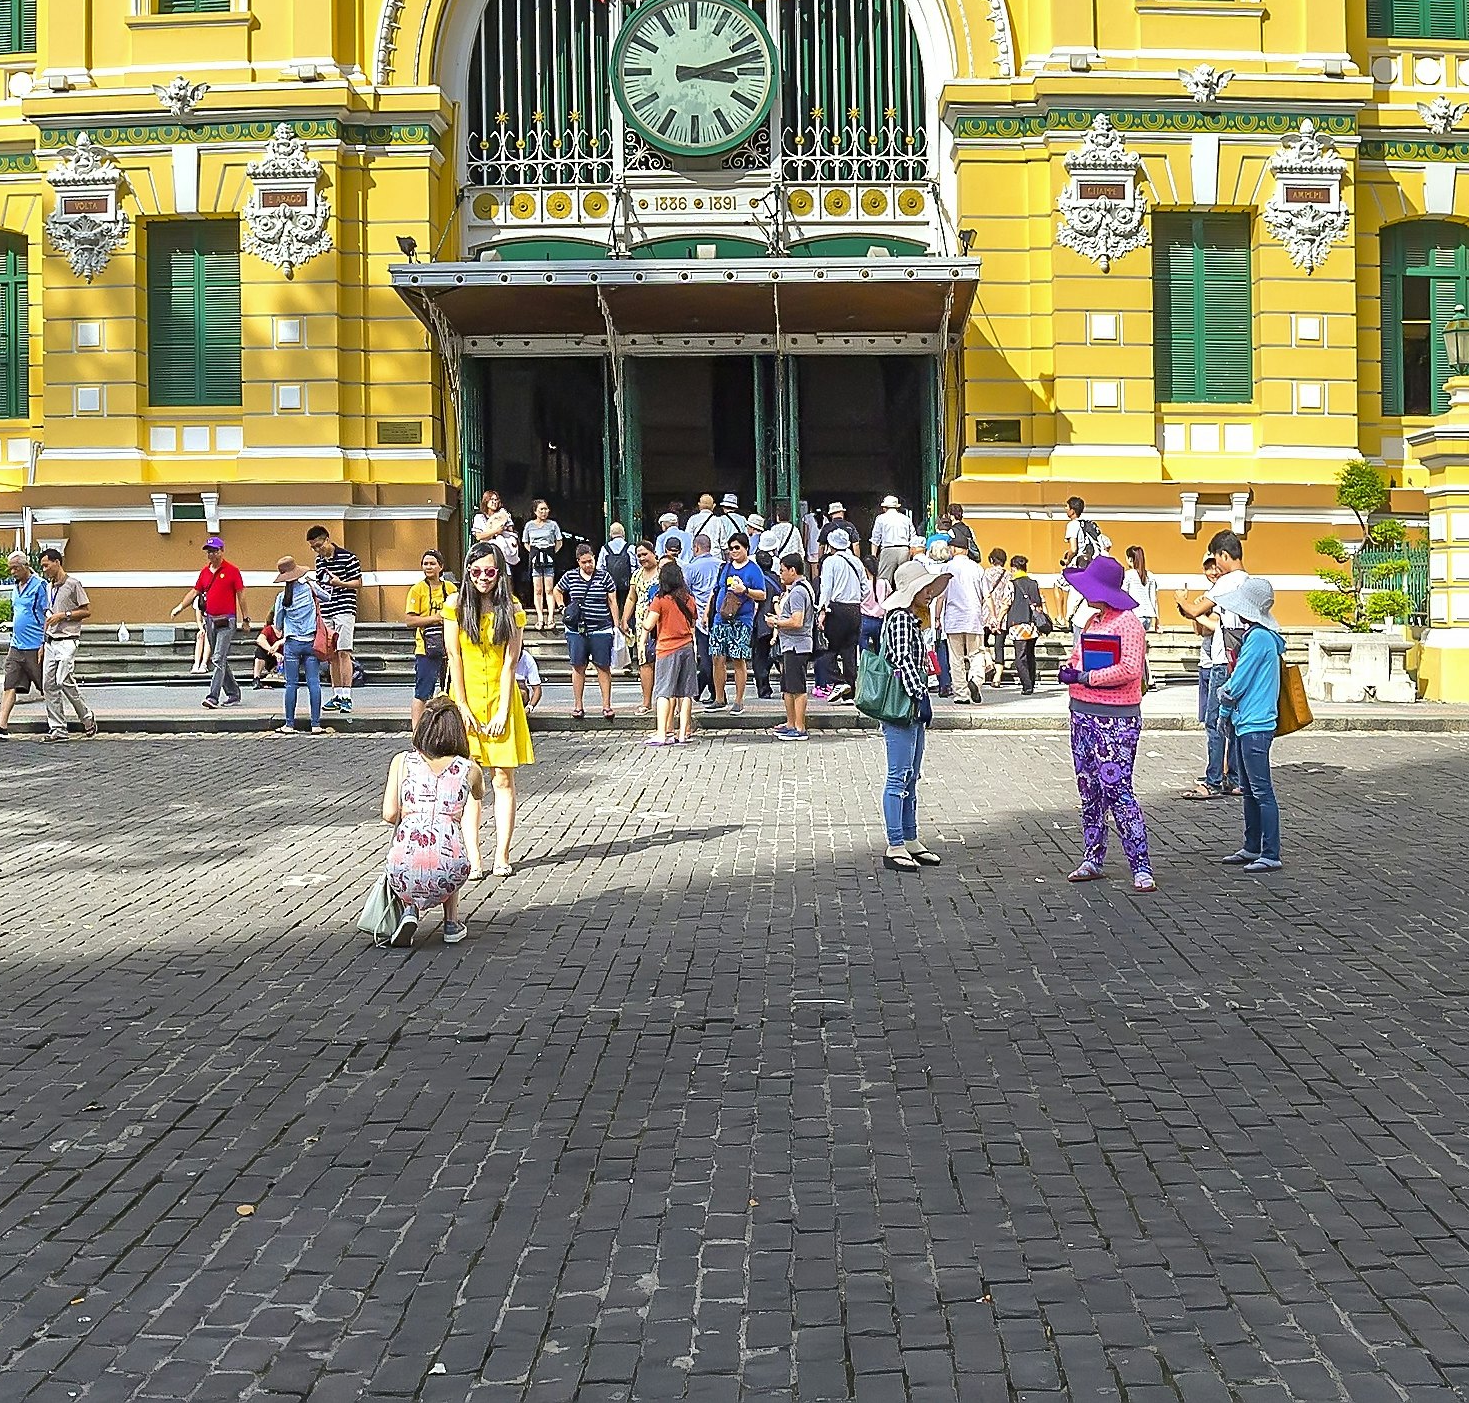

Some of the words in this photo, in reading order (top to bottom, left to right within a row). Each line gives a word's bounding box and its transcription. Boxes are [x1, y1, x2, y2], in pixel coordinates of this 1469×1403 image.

[74, 201, 98, 210] VOLTA
[654, 196, 687, 211] 1886
[708, 196, 737, 210] 1891
